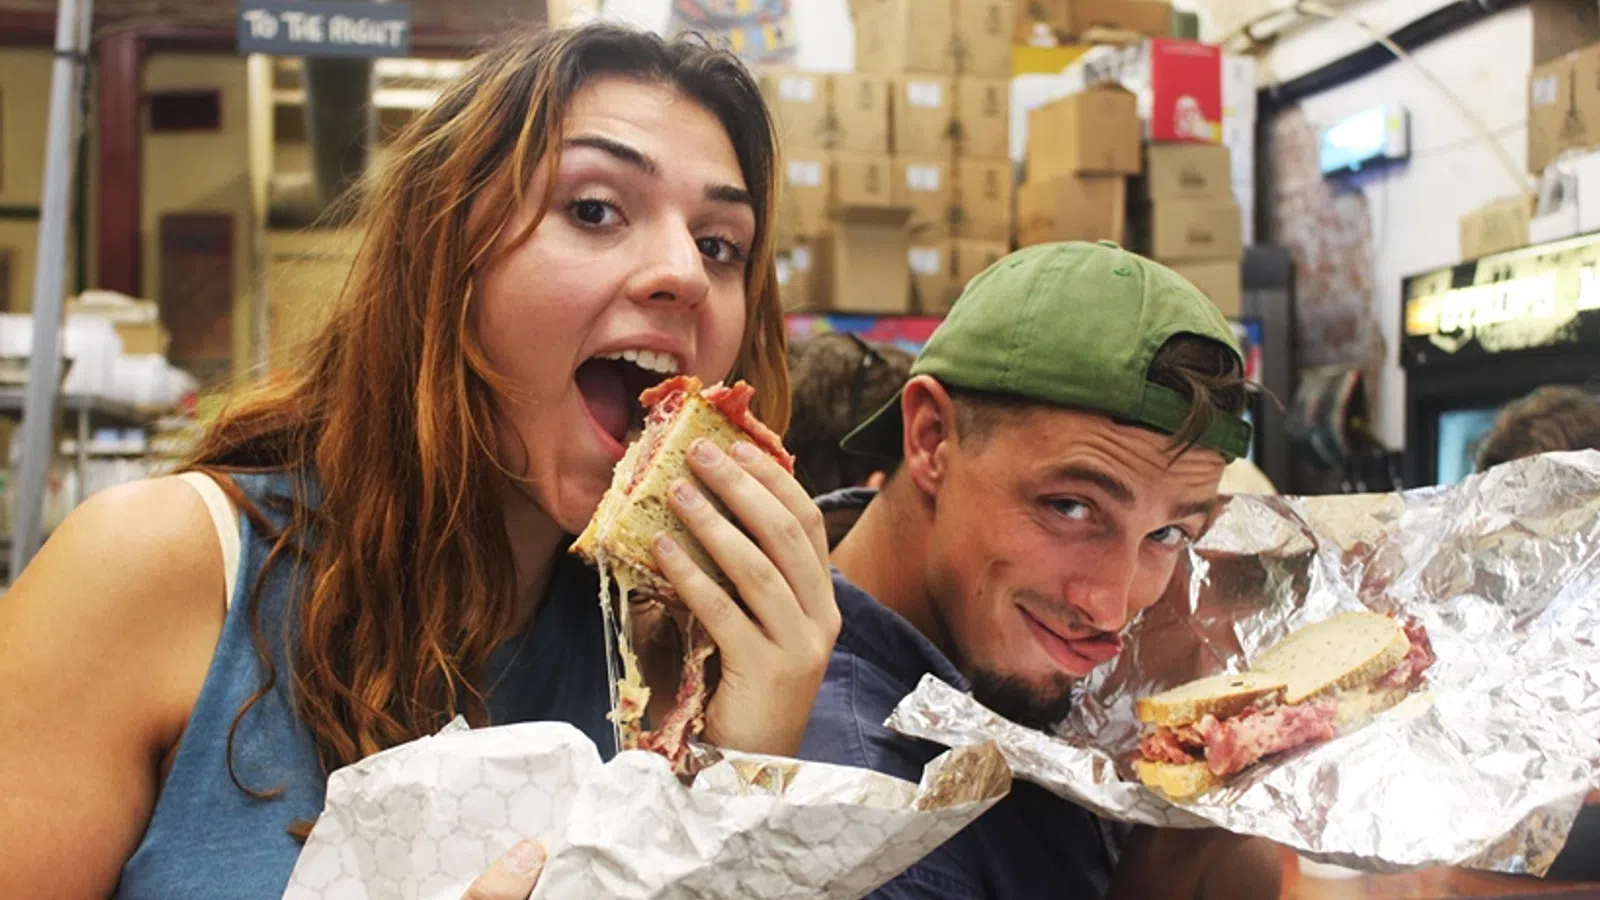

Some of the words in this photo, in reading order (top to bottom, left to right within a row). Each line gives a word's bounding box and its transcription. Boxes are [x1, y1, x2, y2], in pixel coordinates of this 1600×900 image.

[242, 9, 279, 39] TO
[280, 11, 325, 43] THE
[328, 14, 407, 48] RIGHT
